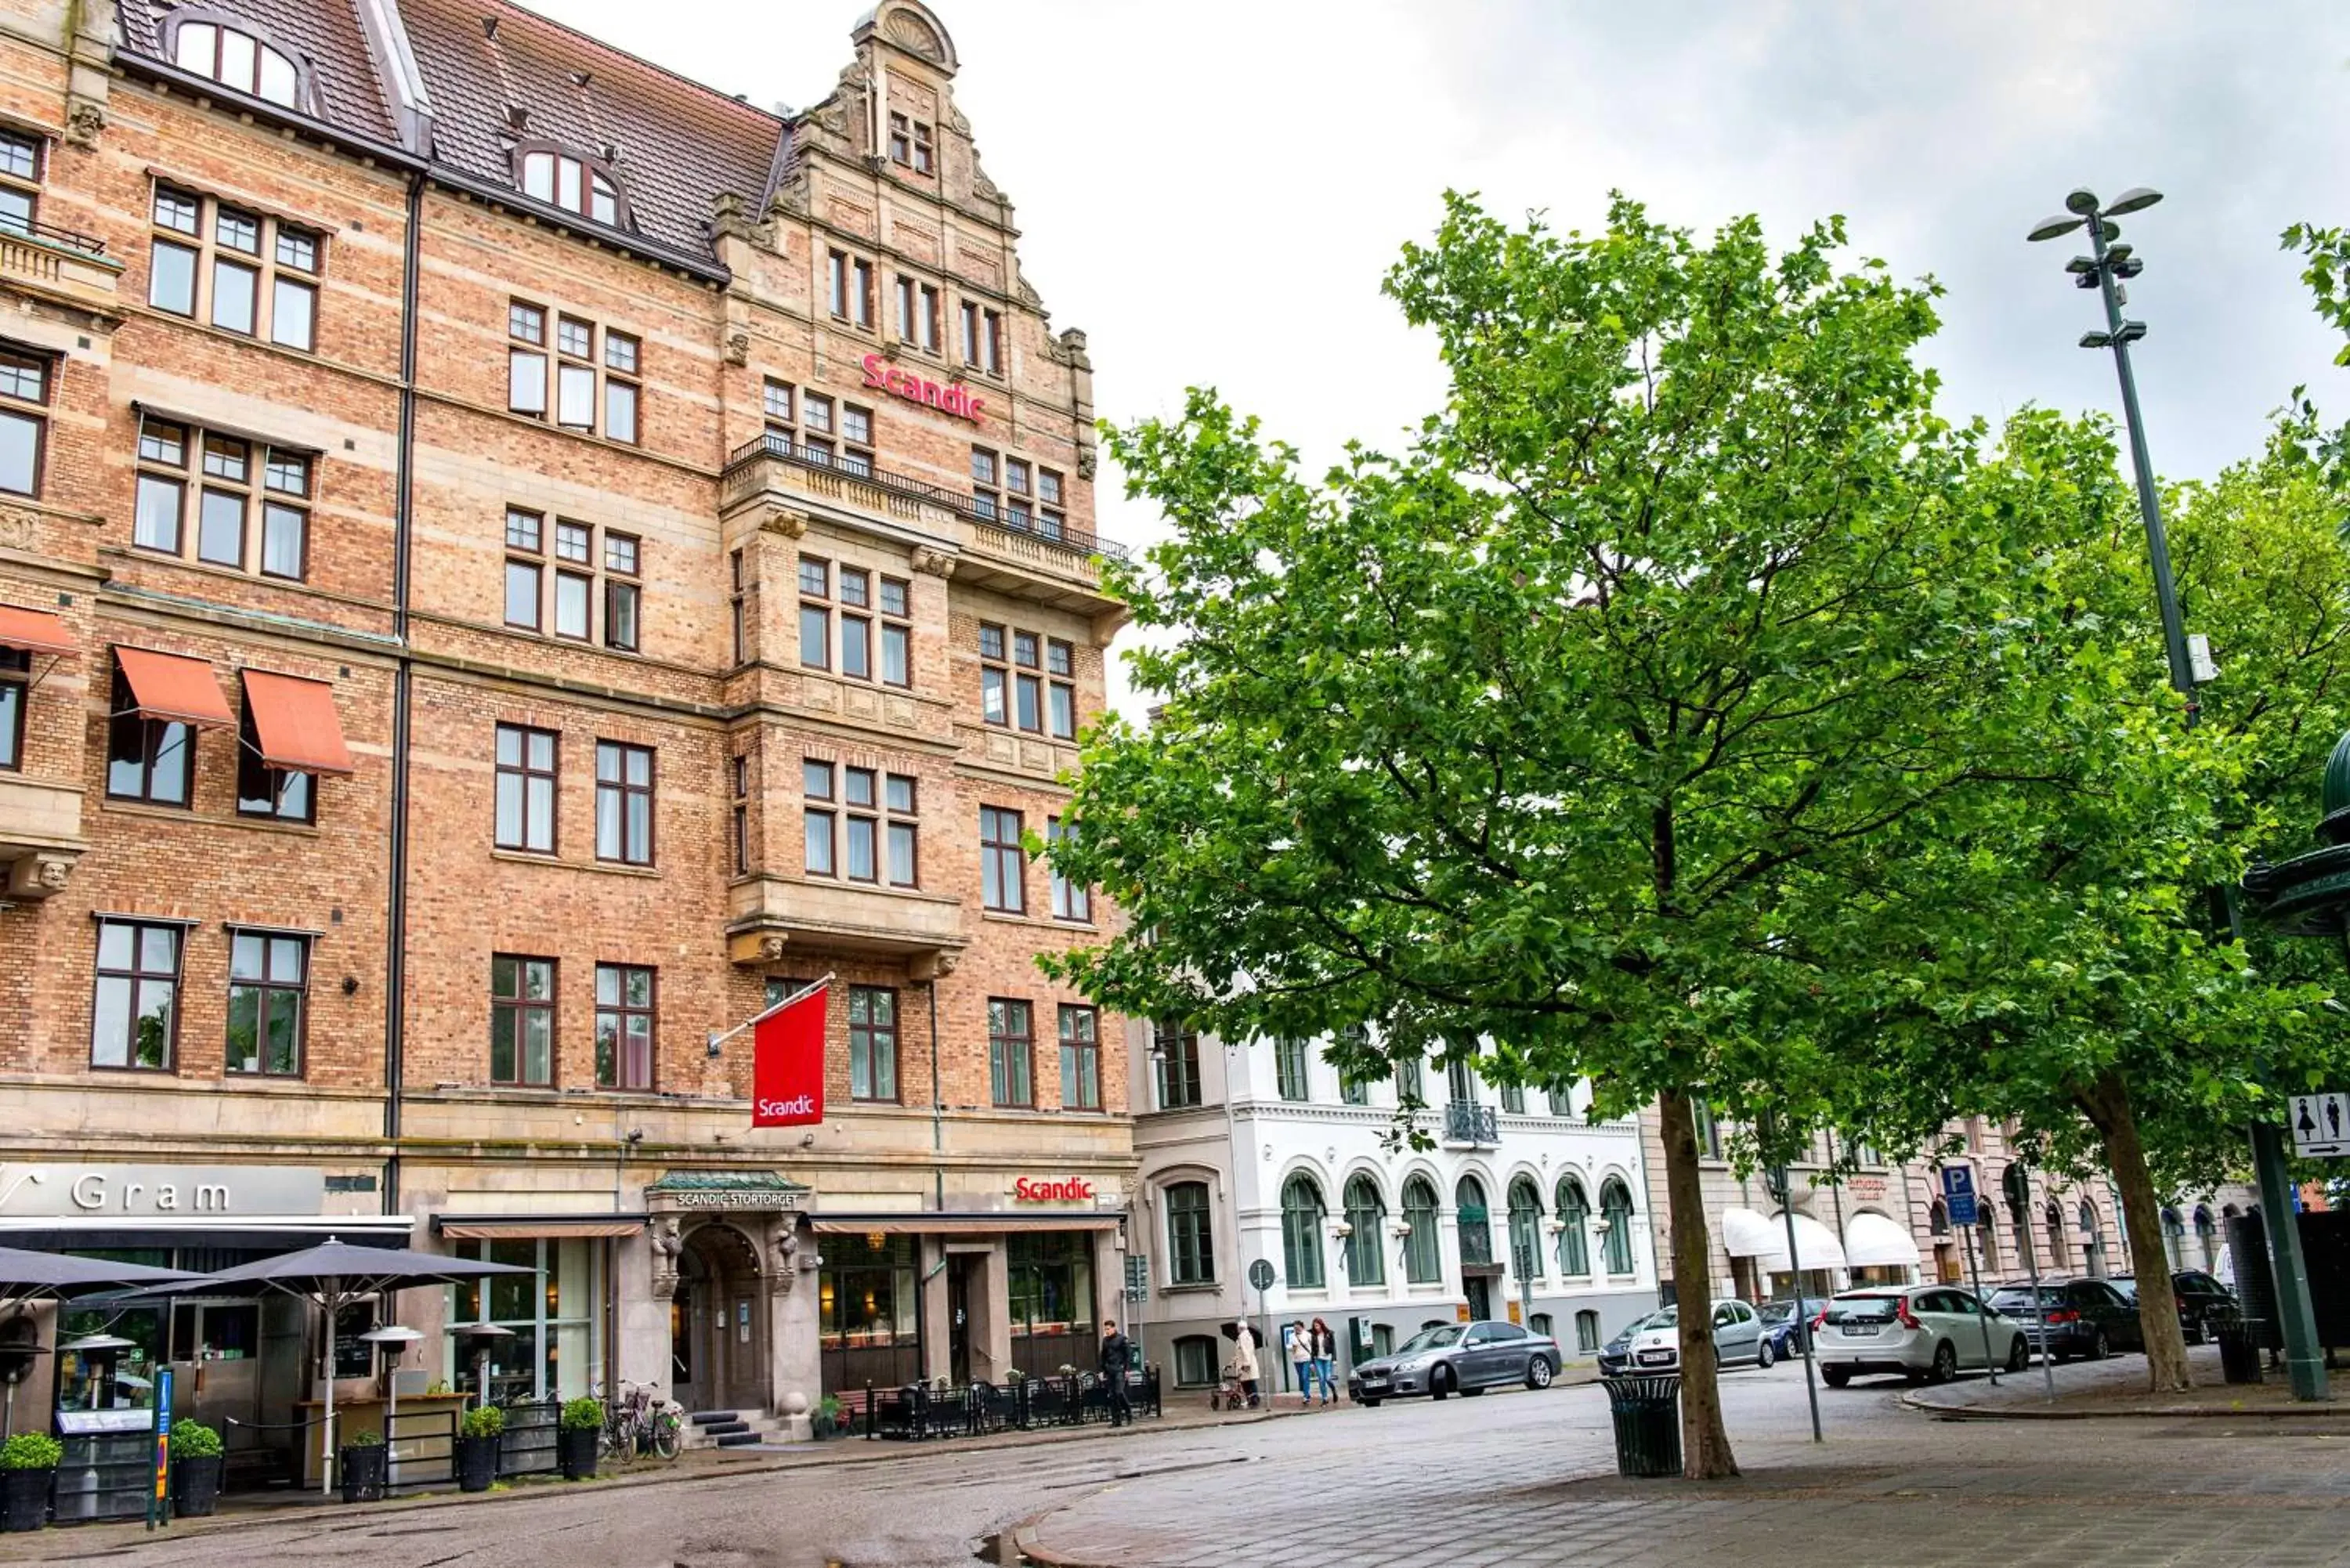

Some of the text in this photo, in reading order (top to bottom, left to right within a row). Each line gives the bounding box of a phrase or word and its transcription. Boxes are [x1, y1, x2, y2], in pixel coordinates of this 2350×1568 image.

[862, 353, 985, 423] Scandic
[758, 1095, 815, 1117] Scandic
[72, 1173, 229, 1210] Gram
[1017, 1176, 1093, 1200] Scandic
[1950, 1169, 1965, 1192] P
[678, 1194, 799, 1206] SCANDIC STORTORGET
